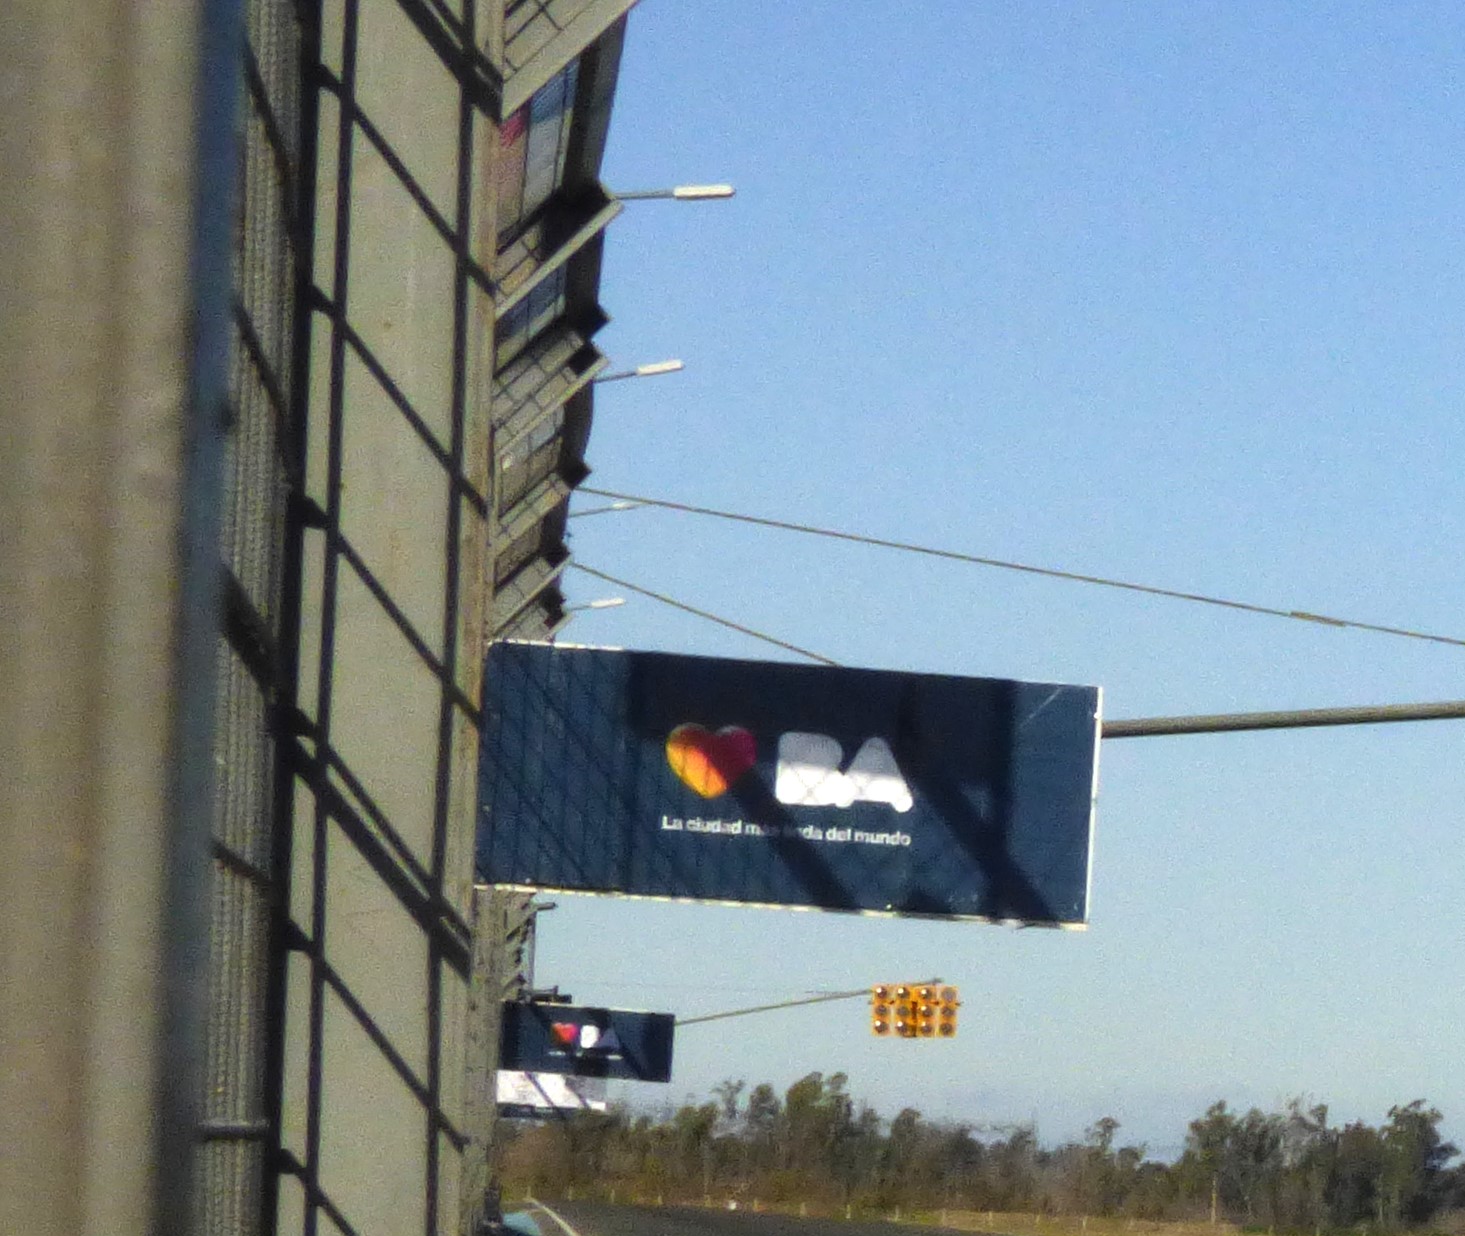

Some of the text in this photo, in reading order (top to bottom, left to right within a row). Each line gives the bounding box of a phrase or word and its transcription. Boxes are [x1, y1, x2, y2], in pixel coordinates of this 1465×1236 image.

[776, 732, 913, 812] BA
[661, 815, 683, 830] La
[686, 817, 742, 834] ciudad
[826, 828, 852, 841] del
[854, 831, 912, 846] mundo
